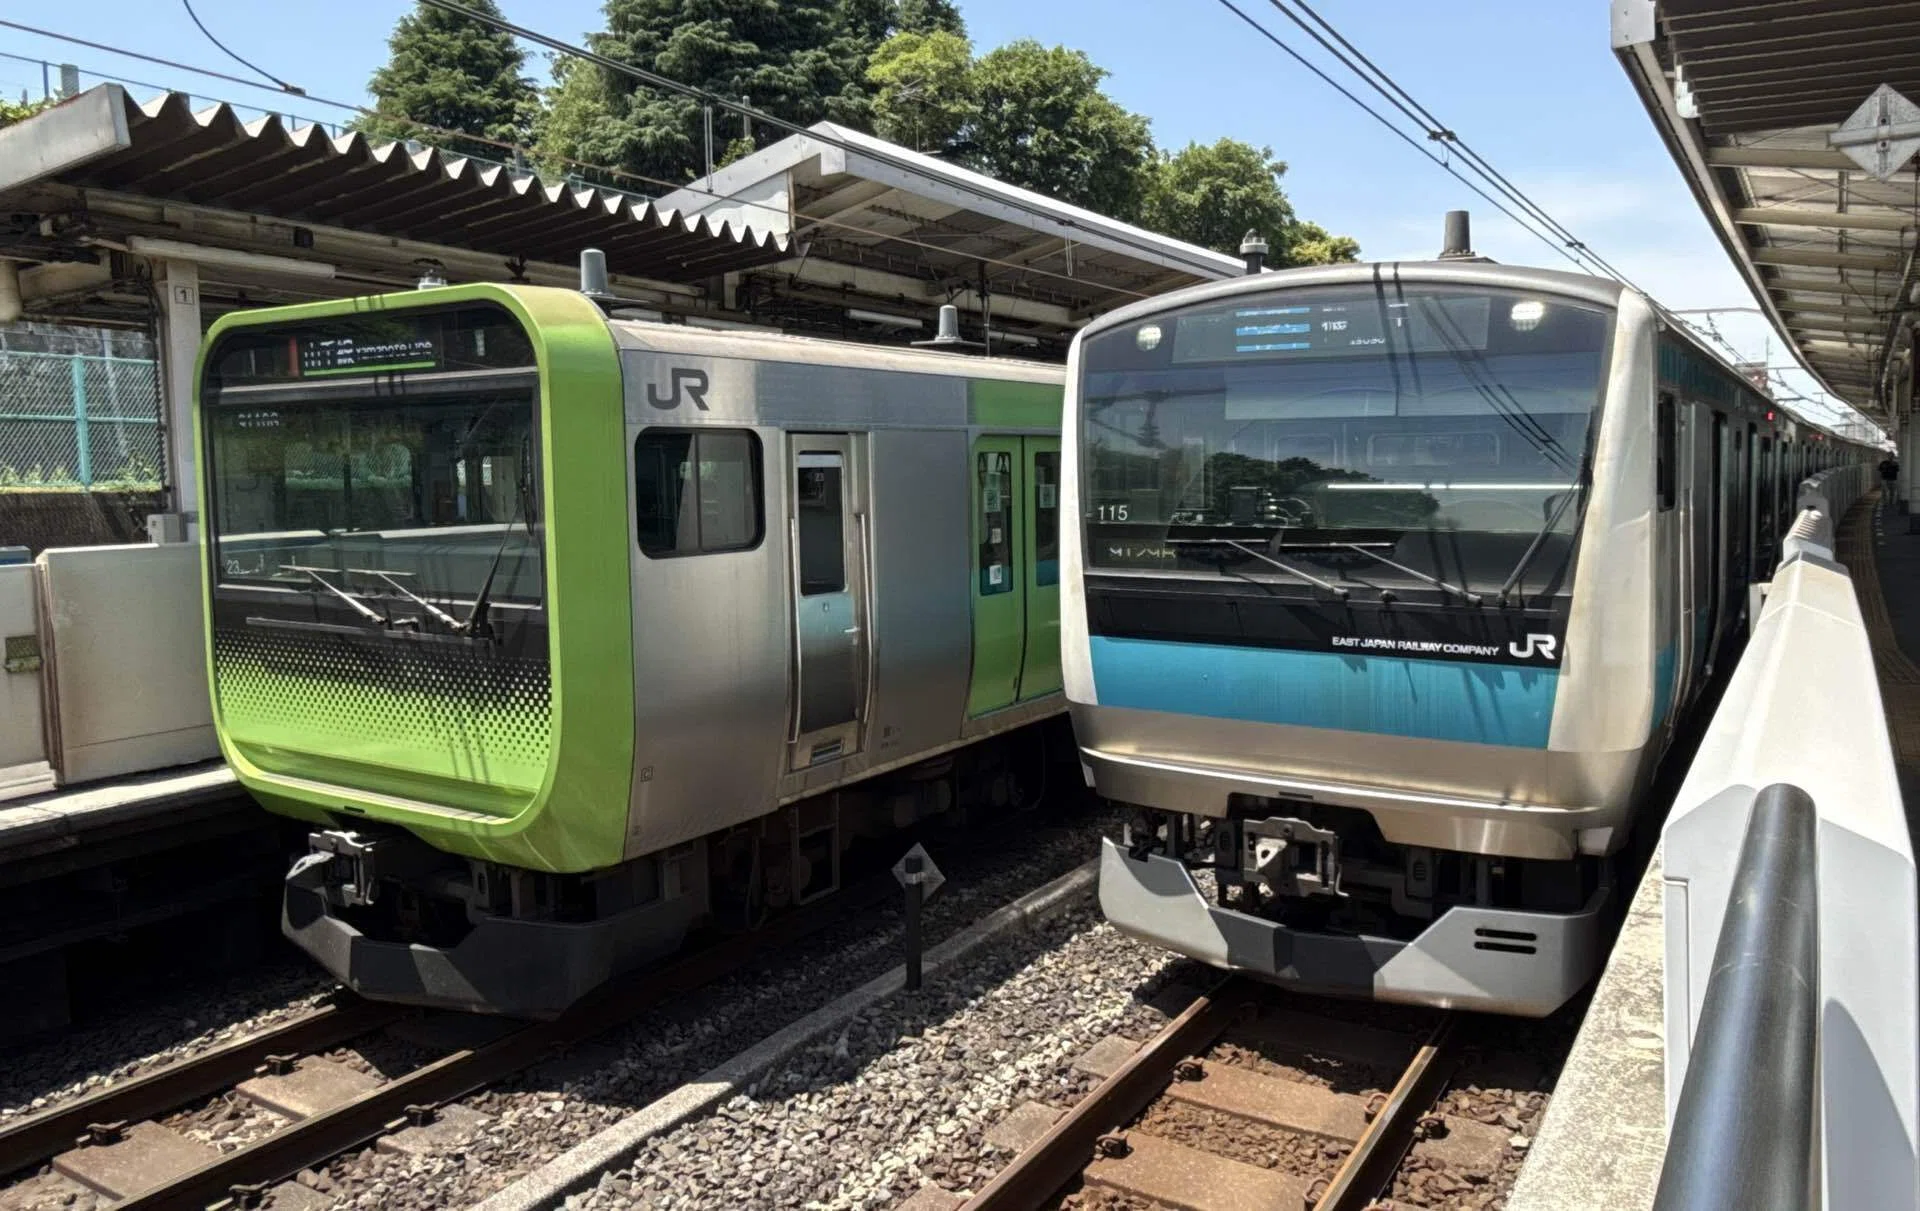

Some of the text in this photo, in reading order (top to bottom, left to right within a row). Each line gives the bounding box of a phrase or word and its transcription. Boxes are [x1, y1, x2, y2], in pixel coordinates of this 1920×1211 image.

[647, 367, 710, 411] JR
[1098, 504, 1128, 521] 115
[1332, 636, 1500, 656] EAST JAPAN RAILWAY COMPANY
[1509, 633, 1557, 660] JR
